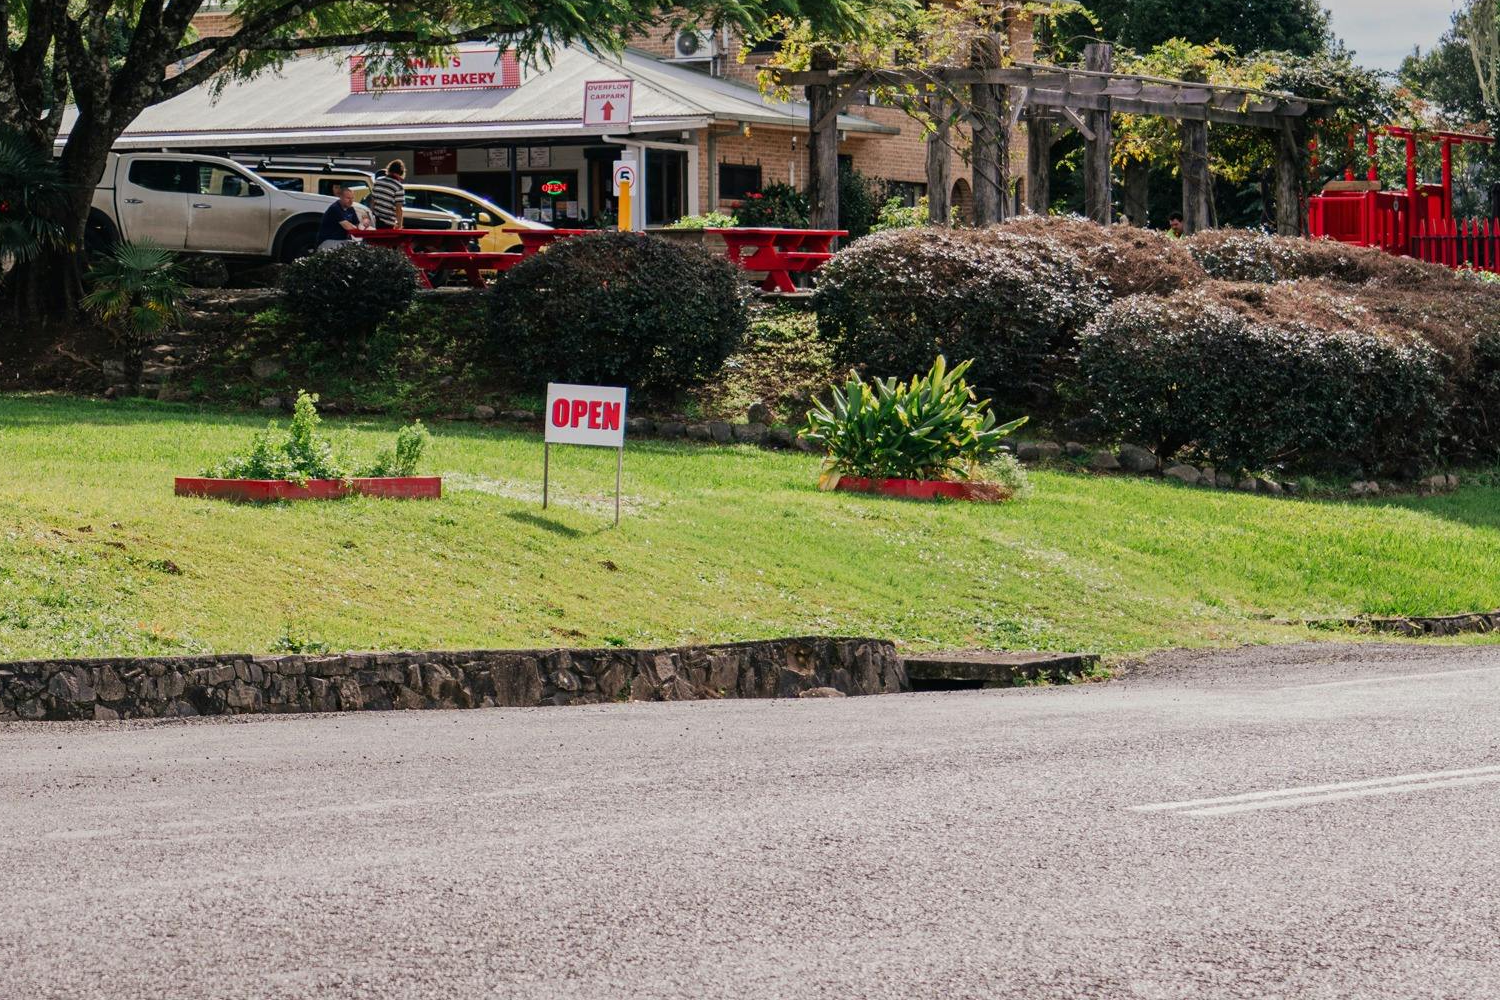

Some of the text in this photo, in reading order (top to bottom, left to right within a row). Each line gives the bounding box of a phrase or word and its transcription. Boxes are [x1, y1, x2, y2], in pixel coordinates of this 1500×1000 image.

[442, 72, 496, 85] BAKERY
[542, 183, 568, 193] OPEN
[552, 398, 621, 430] OPEN
